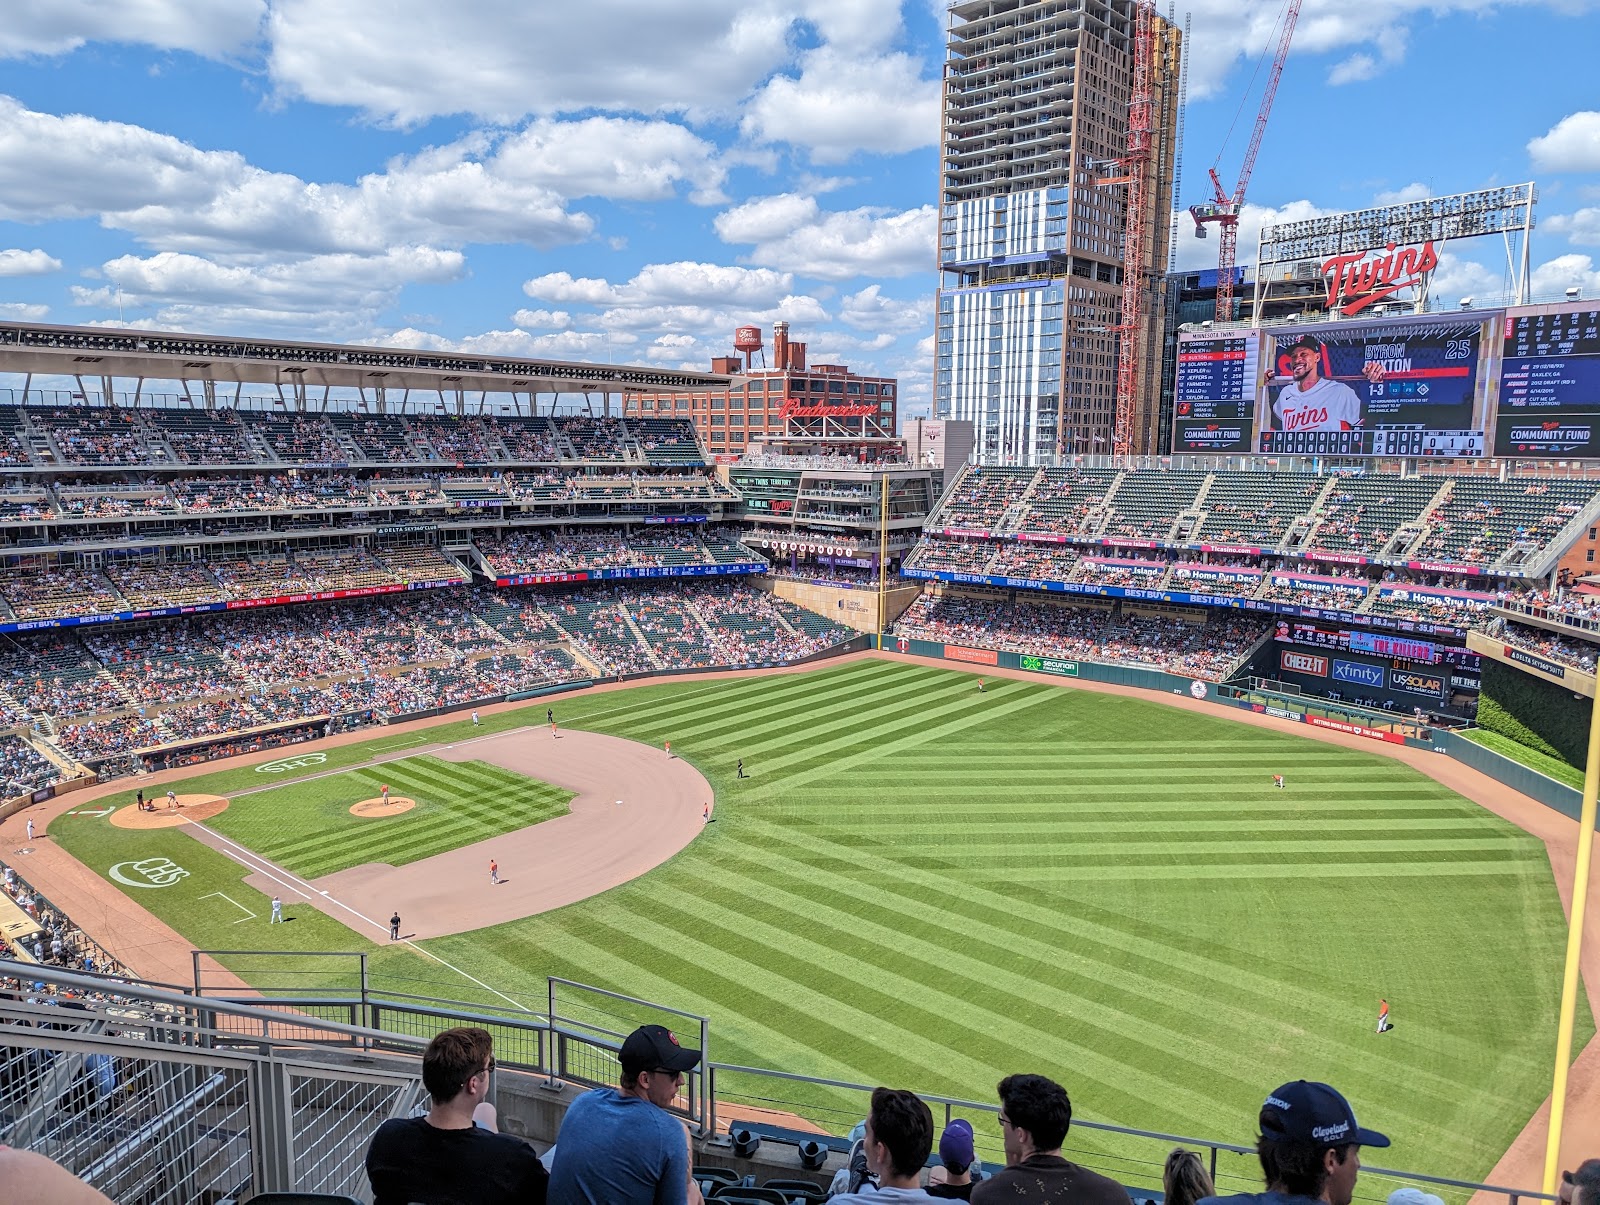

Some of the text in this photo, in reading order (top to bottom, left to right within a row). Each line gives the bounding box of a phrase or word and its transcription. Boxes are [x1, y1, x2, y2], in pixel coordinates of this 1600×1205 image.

[1321, 241, 1437, 315] Twins
[1365, 342, 1406, 360] BYRON
[1445, 340, 1471, 360] 25
[1368, 384, 1384, 396] 1-3
[774, 398, 878, 420] Budweiser
[1283, 405, 1328, 430] Twins
[1510, 430, 1591, 440] COMMUNITY FUND
[1430, 438, 1436, 448] 0
[1468, 438, 1474, 448] 0
[756, 478, 768, 486] TWINS
[770, 478, 792, 486] TERRITORY
[768, 500, 792, 512] Twins
[1108, 540, 1150, 548] Treasure Island
[1312, 554, 1360, 564] Treasure Island
[1133, 566, 1158, 576] Island
[1192, 572, 1217, 581] Home
[1237, 574, 1258, 583] Deck
[1026, 580, 1043, 588] BUY
[1064, 584, 1102, 594] BEST BUY
[1125, 589, 1166, 600] BEST BUY
[1412, 593, 1442, 604] Home
[1190, 595, 1234, 606] BEST BUY
[80, 614, 115, 624] BEST BUY
[17, 622, 38, 630] BEST
[1374, 639, 1429, 660] THE KILLERS
[1043, 660, 1074, 670] securian
[1394, 660, 1412, 670] 0:11
[1516, 654, 1564, 676] DELTA SUITE
[1336, 664, 1382, 684] xfinity
[1451, 676, 1463, 684] HIT
[1464, 677, 1476, 686] THE
[1406, 686, 1440, 696] us-solar.com
[1252, 704, 1265, 712] Twins
[1266, 708, 1300, 720] COMMUNITY FUND
[1314, 718, 1384, 738] GETTING MORE KIDS THE GAME
[262, 753, 327, 773] CHS
[130, 858, 190, 886] CHS
[1264, 1096, 1291, 1110] SRIXON
[1312, 1120, 1350, 1138] Cleveland
[1324, 1133, 1344, 1142] GOLF
